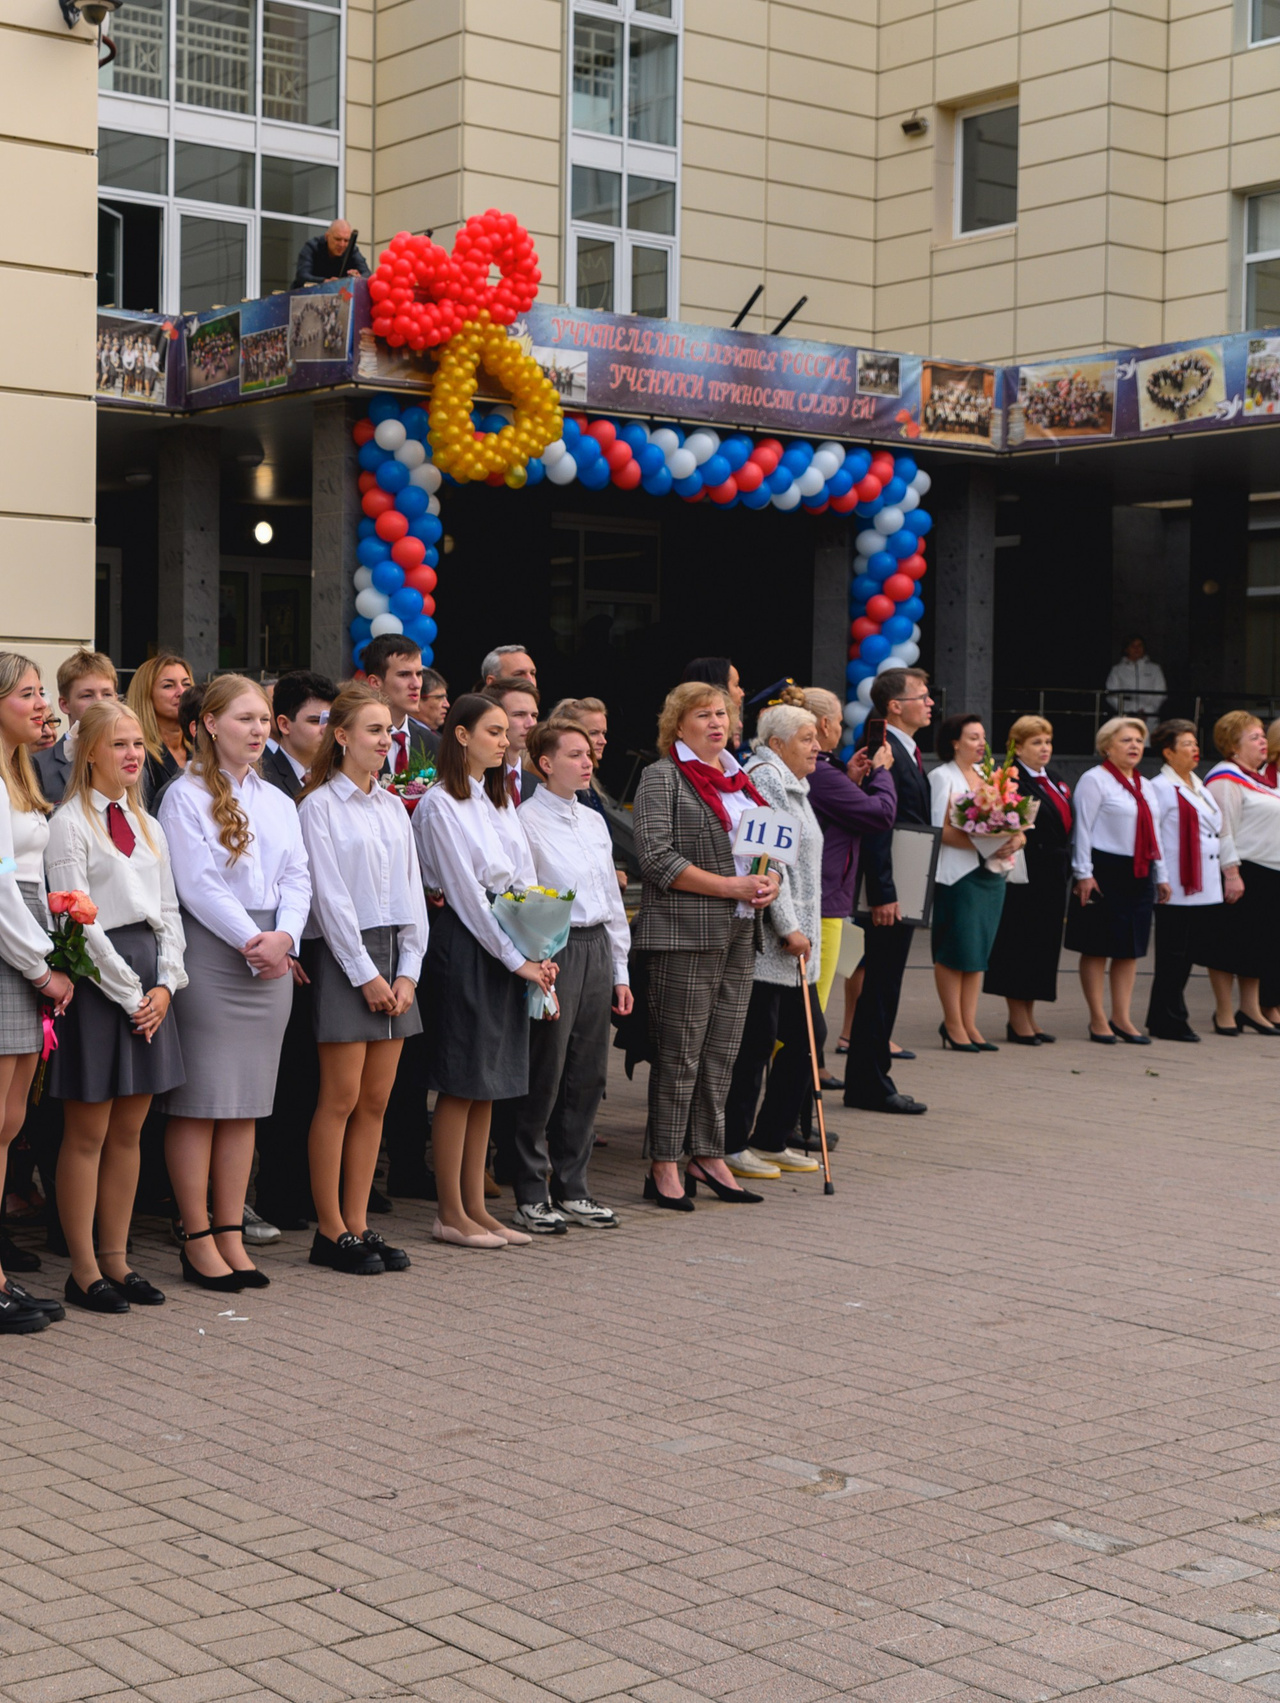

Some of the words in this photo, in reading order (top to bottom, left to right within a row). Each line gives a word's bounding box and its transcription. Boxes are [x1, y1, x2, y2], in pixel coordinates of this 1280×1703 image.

[551, 317, 686, 359] УЧИТЕЛЯМИ
[689, 340, 777, 372] СЛАВИТСЯ
[781, 351, 852, 385] РОССИЯ,
[609, 363, 704, 399] УЧЕНИКИ
[708, 380, 795, 411] ПРИНОСЯТ
[798, 392, 850, 417] СЛАВУ
[851, 395, 877, 420] ЕЙ!
[743, 819, 767, 845] 11
[773, 824, 793, 849] Б
